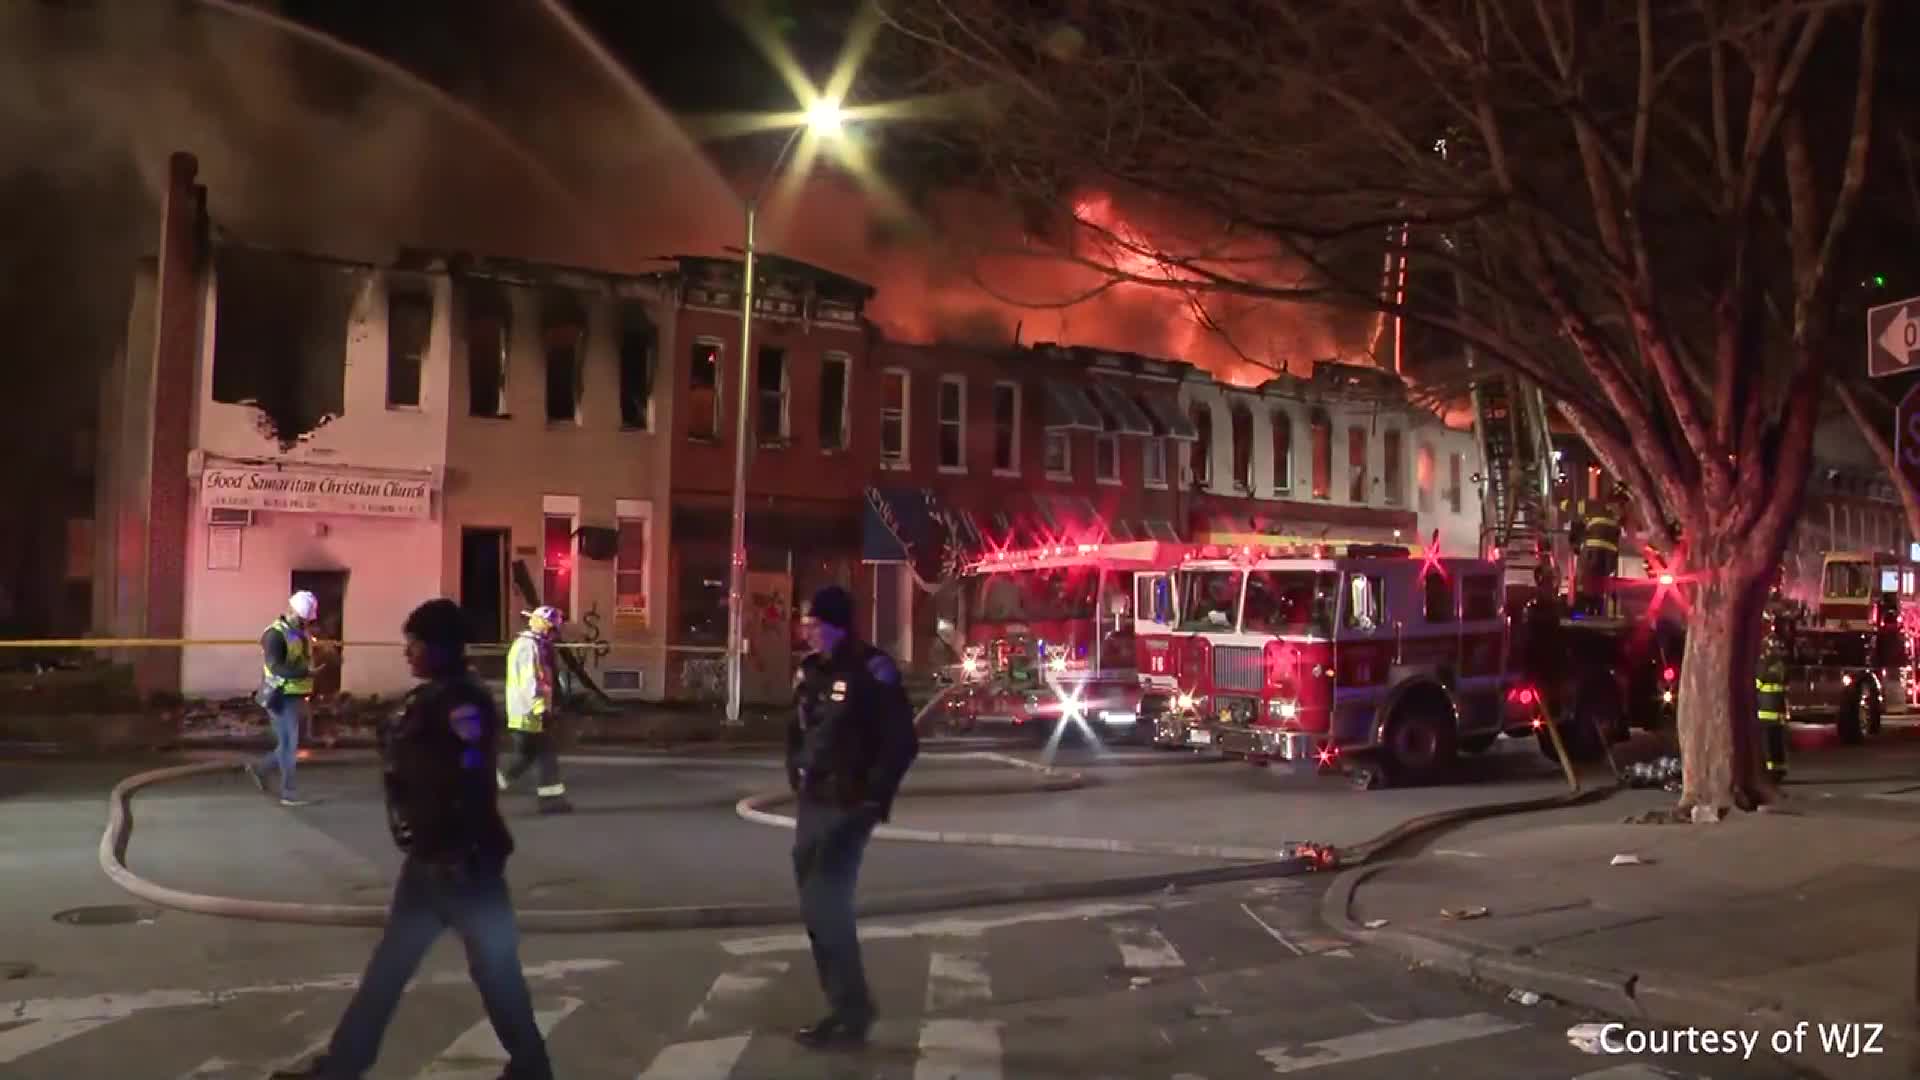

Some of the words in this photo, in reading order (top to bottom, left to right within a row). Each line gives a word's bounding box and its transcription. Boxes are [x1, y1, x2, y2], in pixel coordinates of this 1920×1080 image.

[206, 471, 246, 489] Good
[247, 473, 317, 493] Samaritan
[319, 477, 381, 497] Christian
[383, 481, 426, 498] Church
